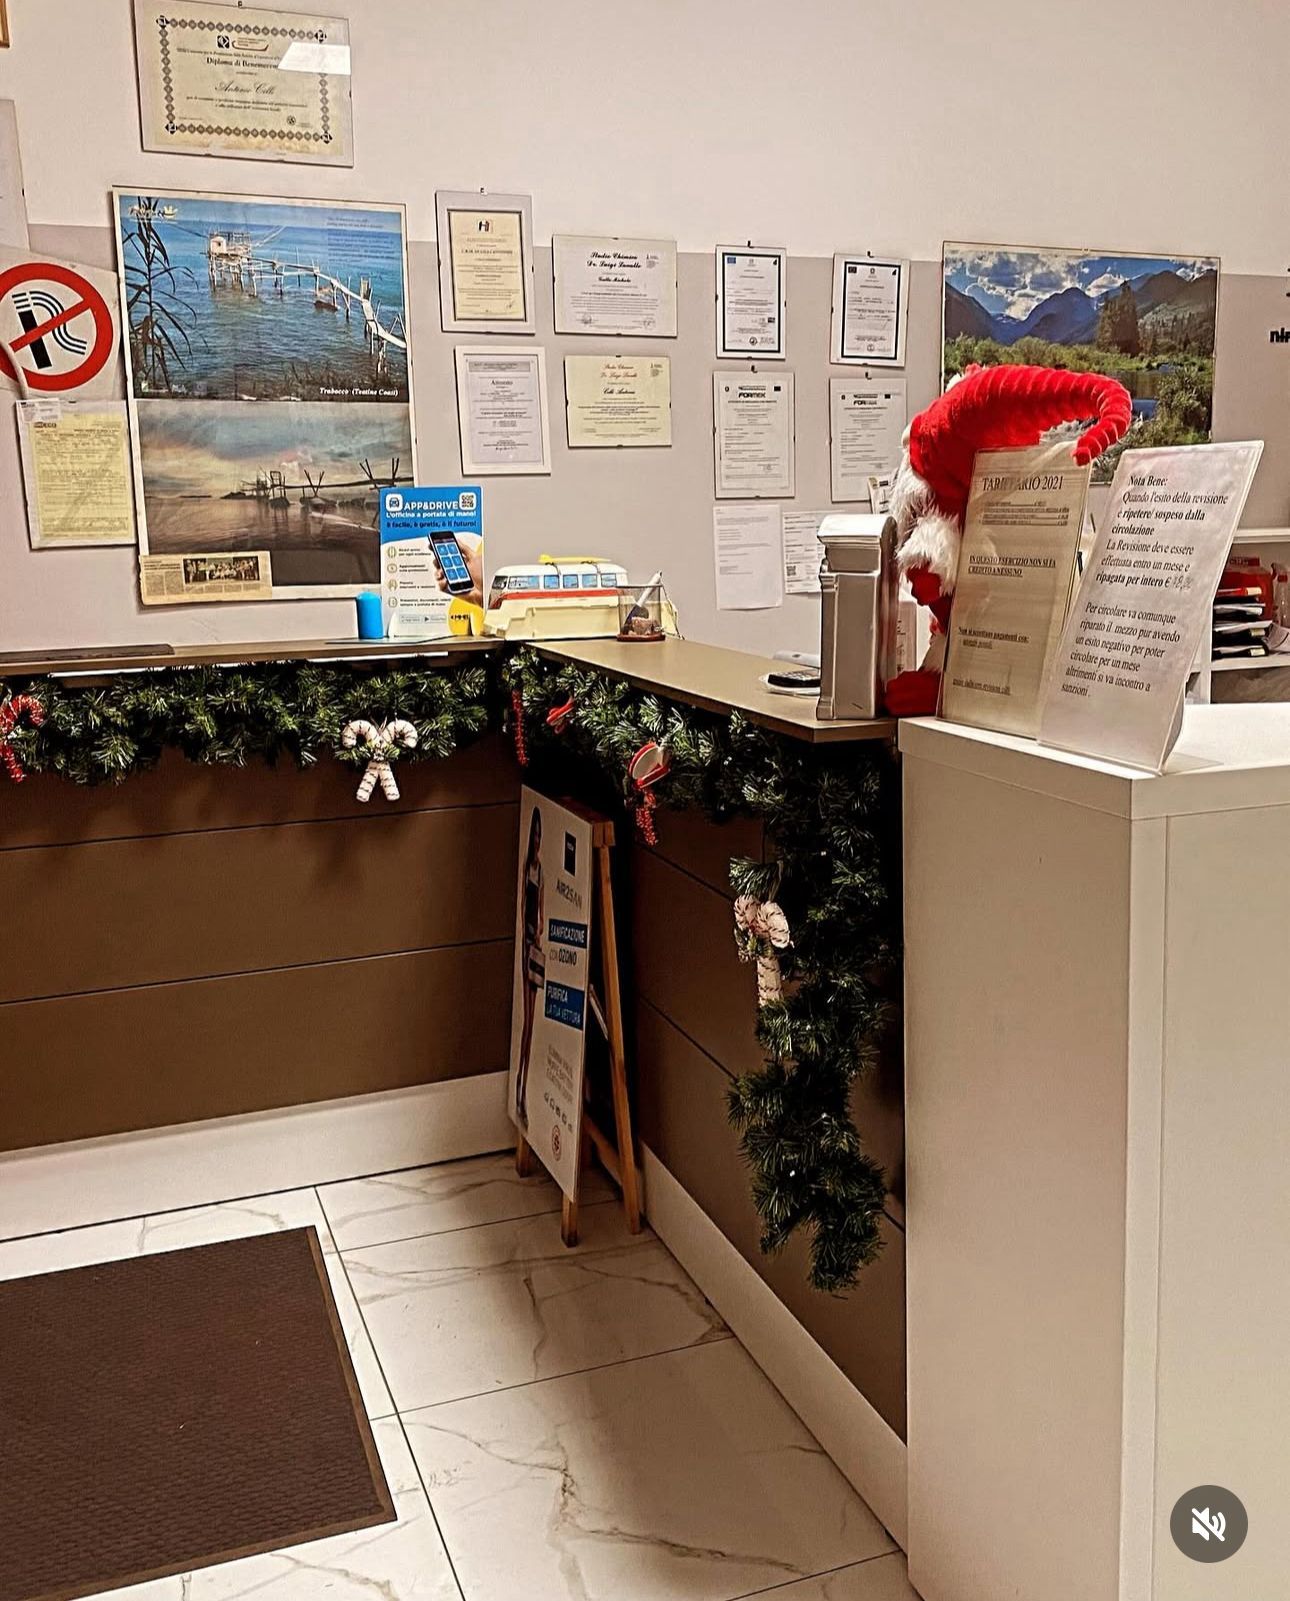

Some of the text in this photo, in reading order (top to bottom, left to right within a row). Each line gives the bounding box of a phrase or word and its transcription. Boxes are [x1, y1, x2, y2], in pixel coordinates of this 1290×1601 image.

[206, 57, 233, 66] Diploma
[320, 387, 349, 395] Trabocco
[982, 476, 1064, 491] TARIRIO 2021
[1128, 476, 1168, 486] Nota Bene:
[404, 500, 458, 510] APP&DRIVE
[1122, 492, 1149, 504] Quando
[1172, 492, 1190, 504] della
[1192, 492, 1228, 505] revisione
[1155, 511, 1184, 522] sospeso
[1184, 510, 1205, 521] dalla
[419, 521, 440, 529] gratis,
[1112, 524, 1154, 536] circolazione
[1106, 539, 1194, 556] La Revisione deve essere
[1133, 558, 1152, 570] entro
[1152, 561, 1162, 570] un
[1163, 562, 1184, 572] mese
[1184, 563, 1190, 572] e
[1096, 570, 1126, 585] ripagata
[1126, 575, 1140, 587] per
[1140, 575, 1164, 587] intero
[1086, 602, 1176, 626] Per circolare va comunque
[1080, 618, 1180, 642] riparato il mezzo pur avendo
[1075, 635, 1166, 658] un esito negativo per poter
[1070, 650, 1140, 672] circolare per un mese
[1066, 665, 1151, 692] altrimenti si va incontro a
[556, 879, 582, 909] AIR2SAN
[550, 924, 584, 944] SANIFICAZIONE
[558, 948, 577, 966] OZONO
[547, 985, 568, 1004] PURIFICA
